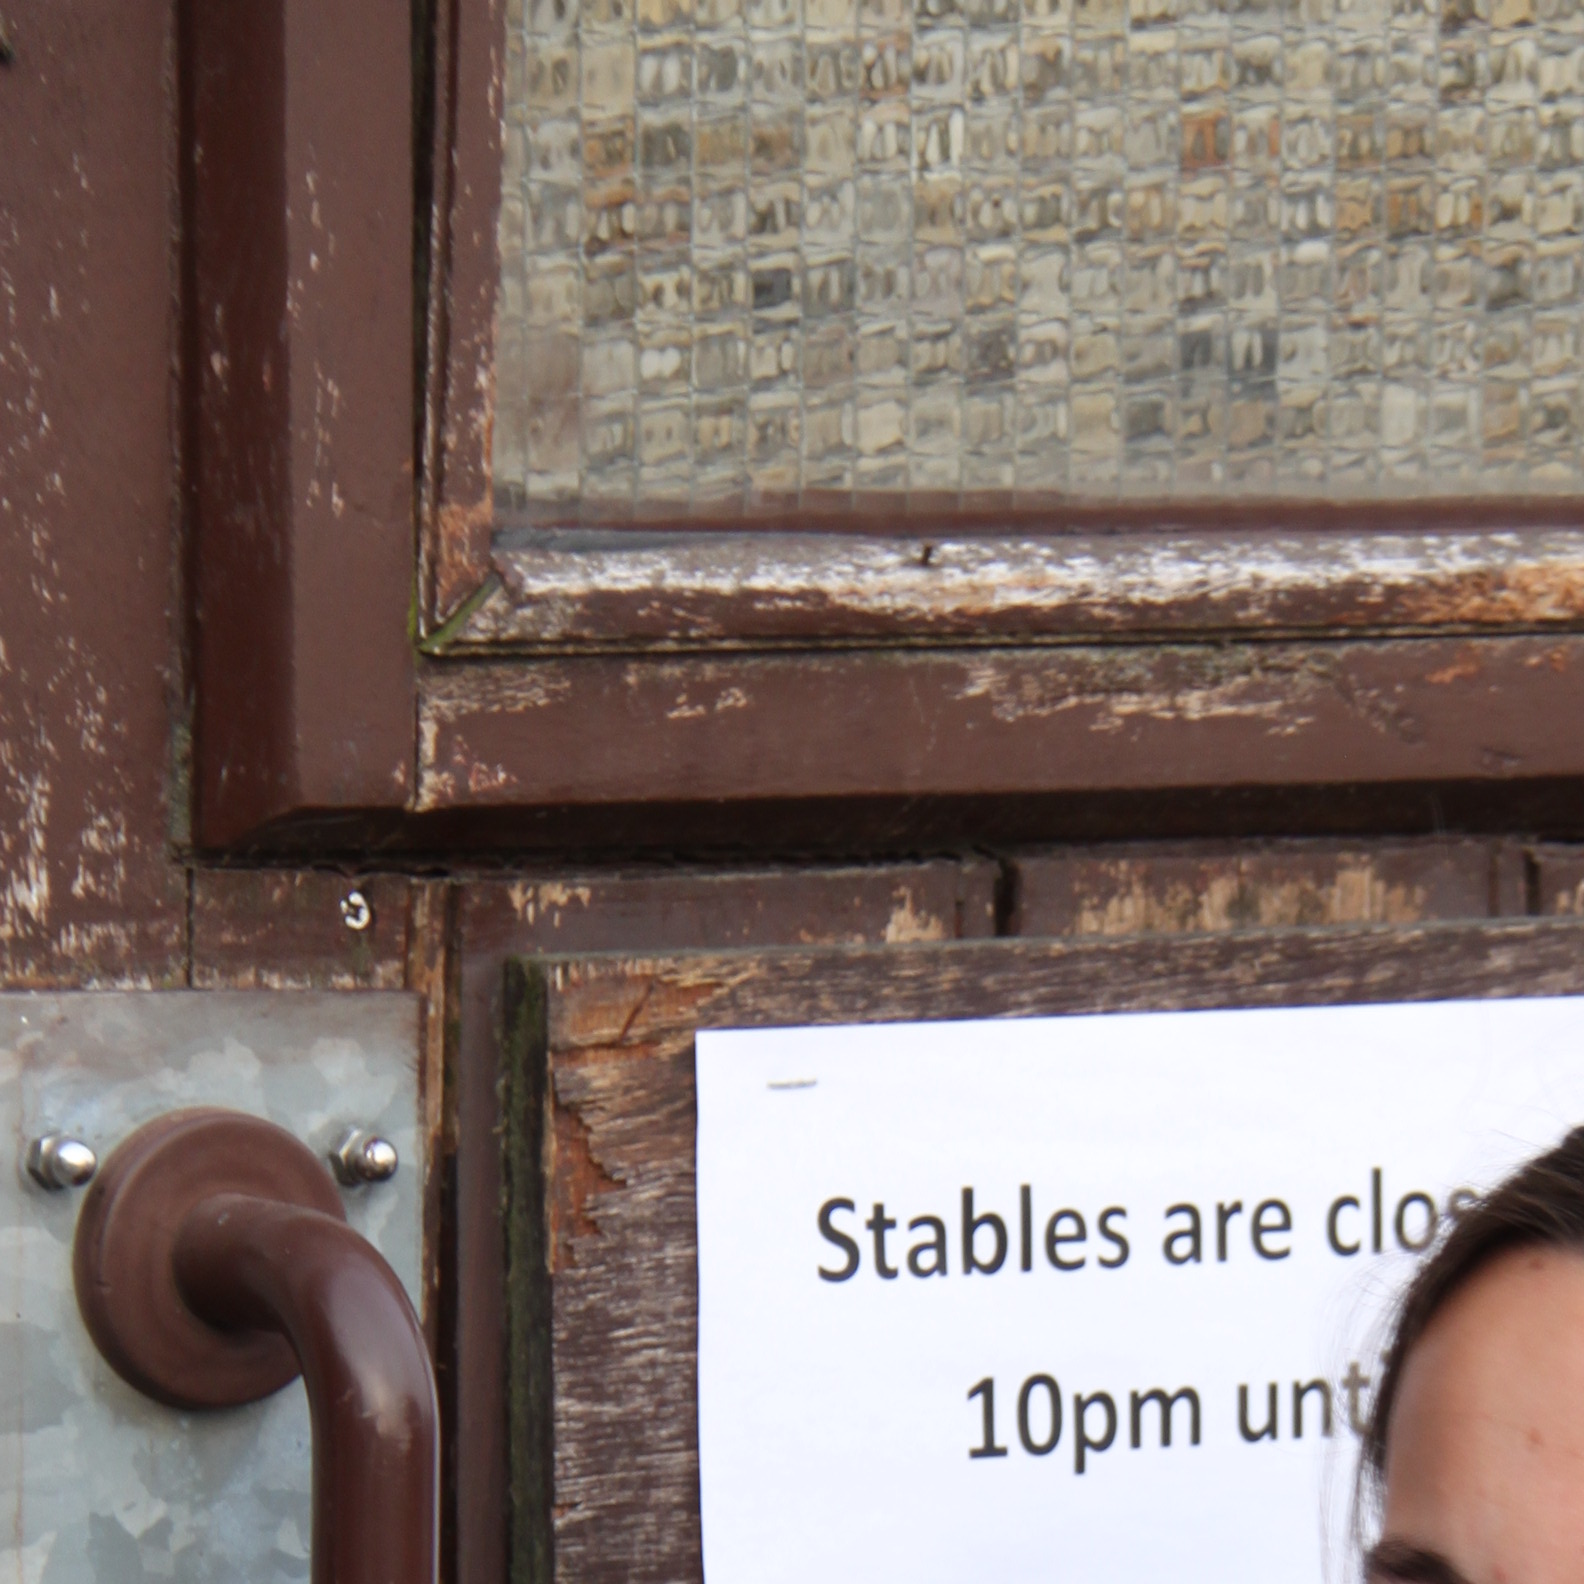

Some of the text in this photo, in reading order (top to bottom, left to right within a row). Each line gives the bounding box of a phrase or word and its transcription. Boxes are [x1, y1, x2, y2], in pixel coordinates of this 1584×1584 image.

[816, 1184, 1131, 1284] Stables
[1162, 1198, 1293, 1267] are
[967, 1372, 1202, 1476] 10pm
